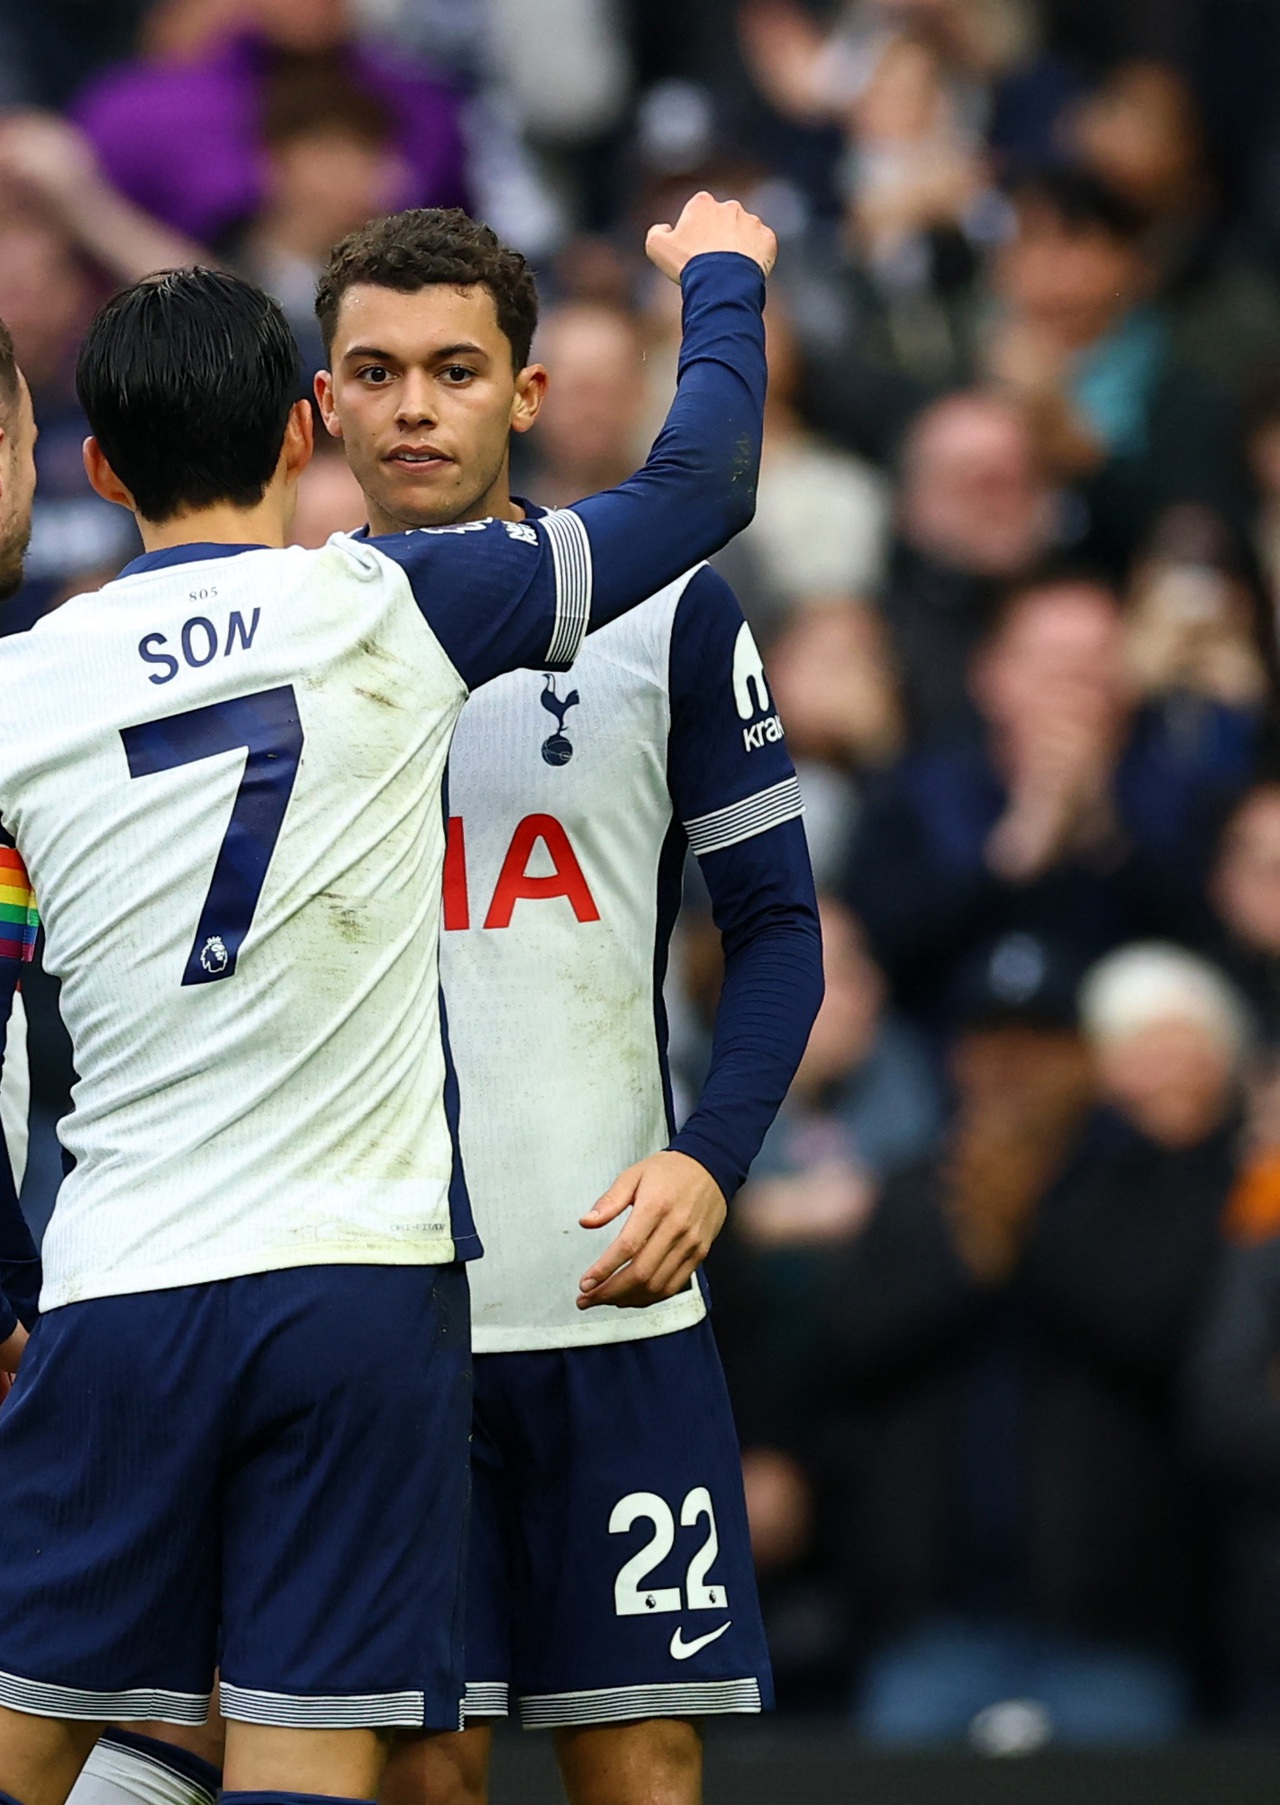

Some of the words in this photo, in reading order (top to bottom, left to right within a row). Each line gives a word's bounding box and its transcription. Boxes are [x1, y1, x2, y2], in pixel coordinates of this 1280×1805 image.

[138, 607, 261, 685] SON
[119, 684, 305, 987] 7
[608, 1487, 728, 1616] 22
